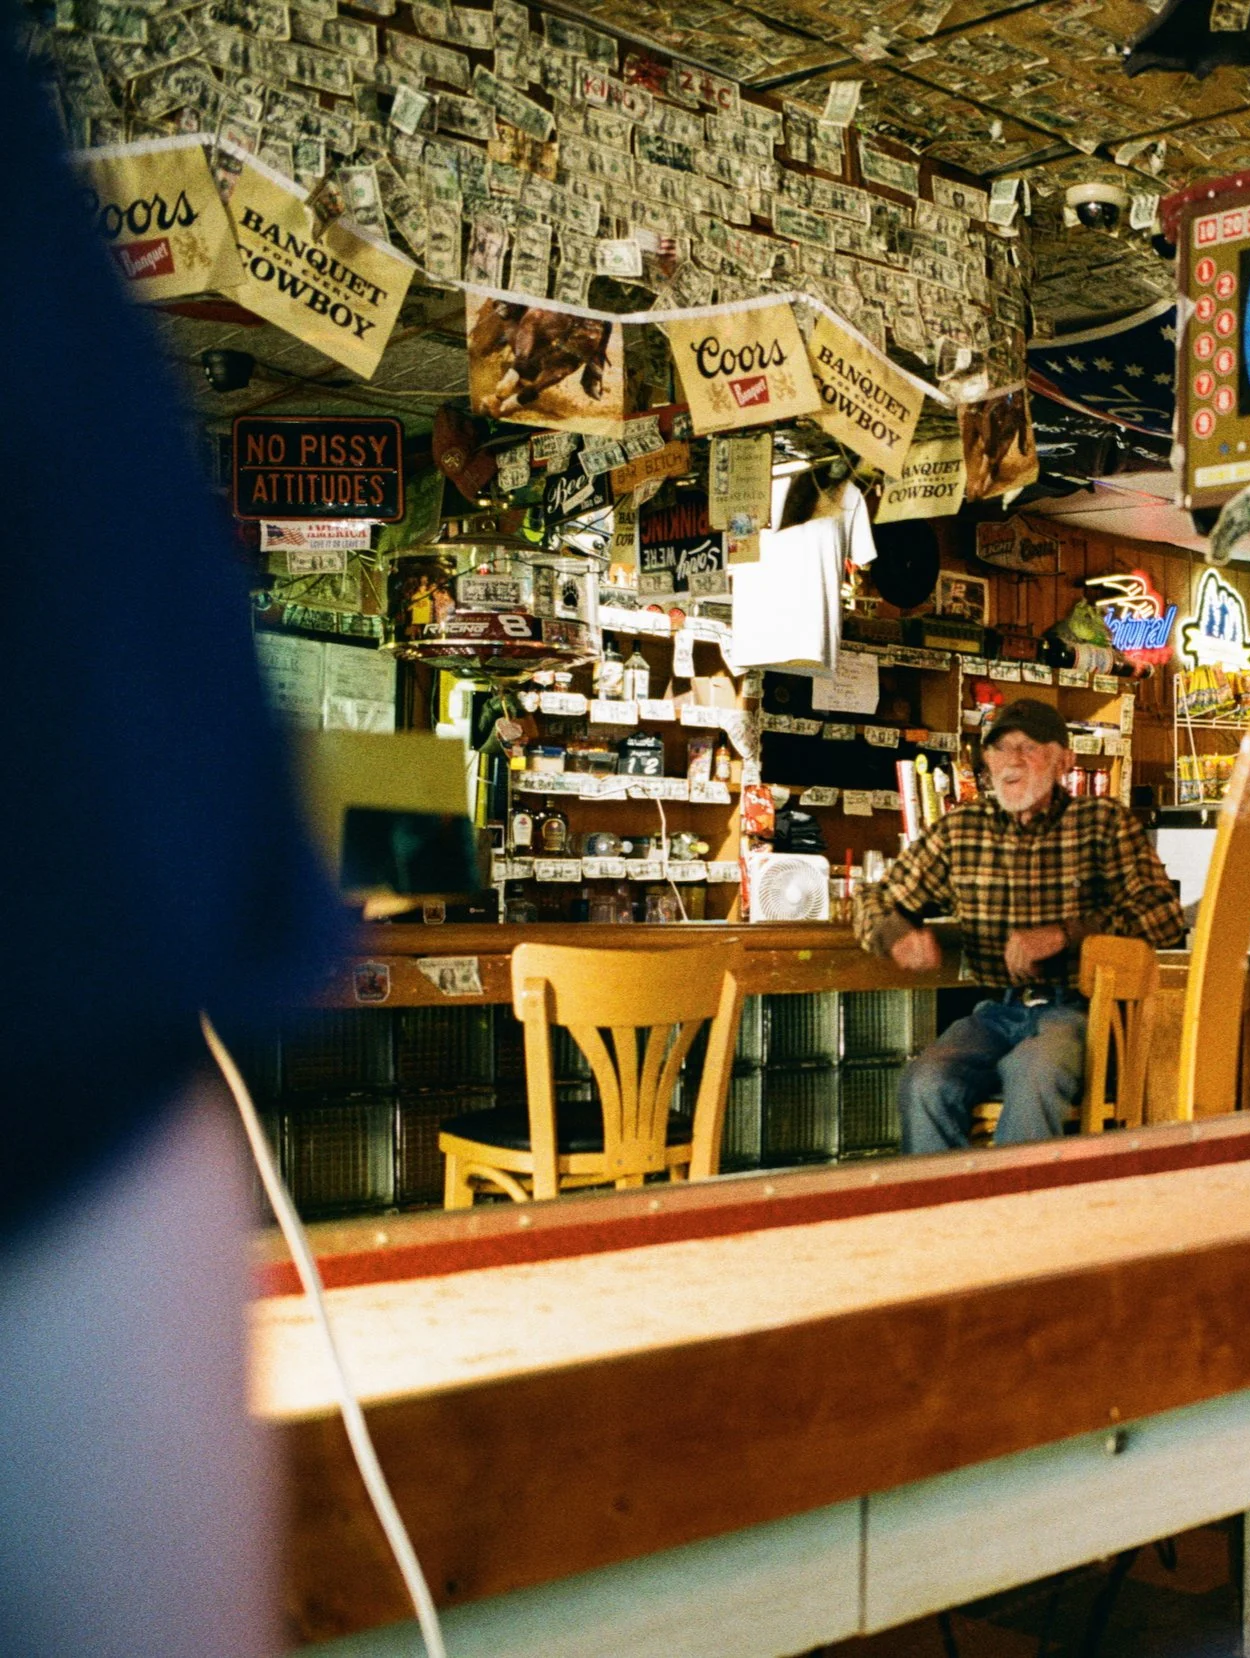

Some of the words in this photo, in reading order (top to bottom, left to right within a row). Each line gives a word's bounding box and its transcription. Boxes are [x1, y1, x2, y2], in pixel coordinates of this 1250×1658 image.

[1199, 221, 1217, 242] 10
[1224, 214, 1242, 236] 20
[119, 241, 169, 277] Banquet
[239, 207, 388, 306] BANQUET
[262, 246, 293, 267] FOR
[301, 268, 351, 301] EVERY
[690, 336, 788, 379] Coors
[817, 345, 910, 423] BANQUET
[247, 434, 286, 464] NO
[301, 434, 388, 465] PISSY
[645, 453, 682, 475] BITCH
[901, 459, 963, 480] ANQUET
[252, 474, 385, 504] ATTITUDES
[547, 475, 586, 514] Bee
[888, 483, 959, 504] COWBOY
[307, 524, 368, 538] AMERICA
[641, 503, 709, 544] RINKING
[423, 622, 489, 636] RACING
[498, 614, 532, 637] 8
